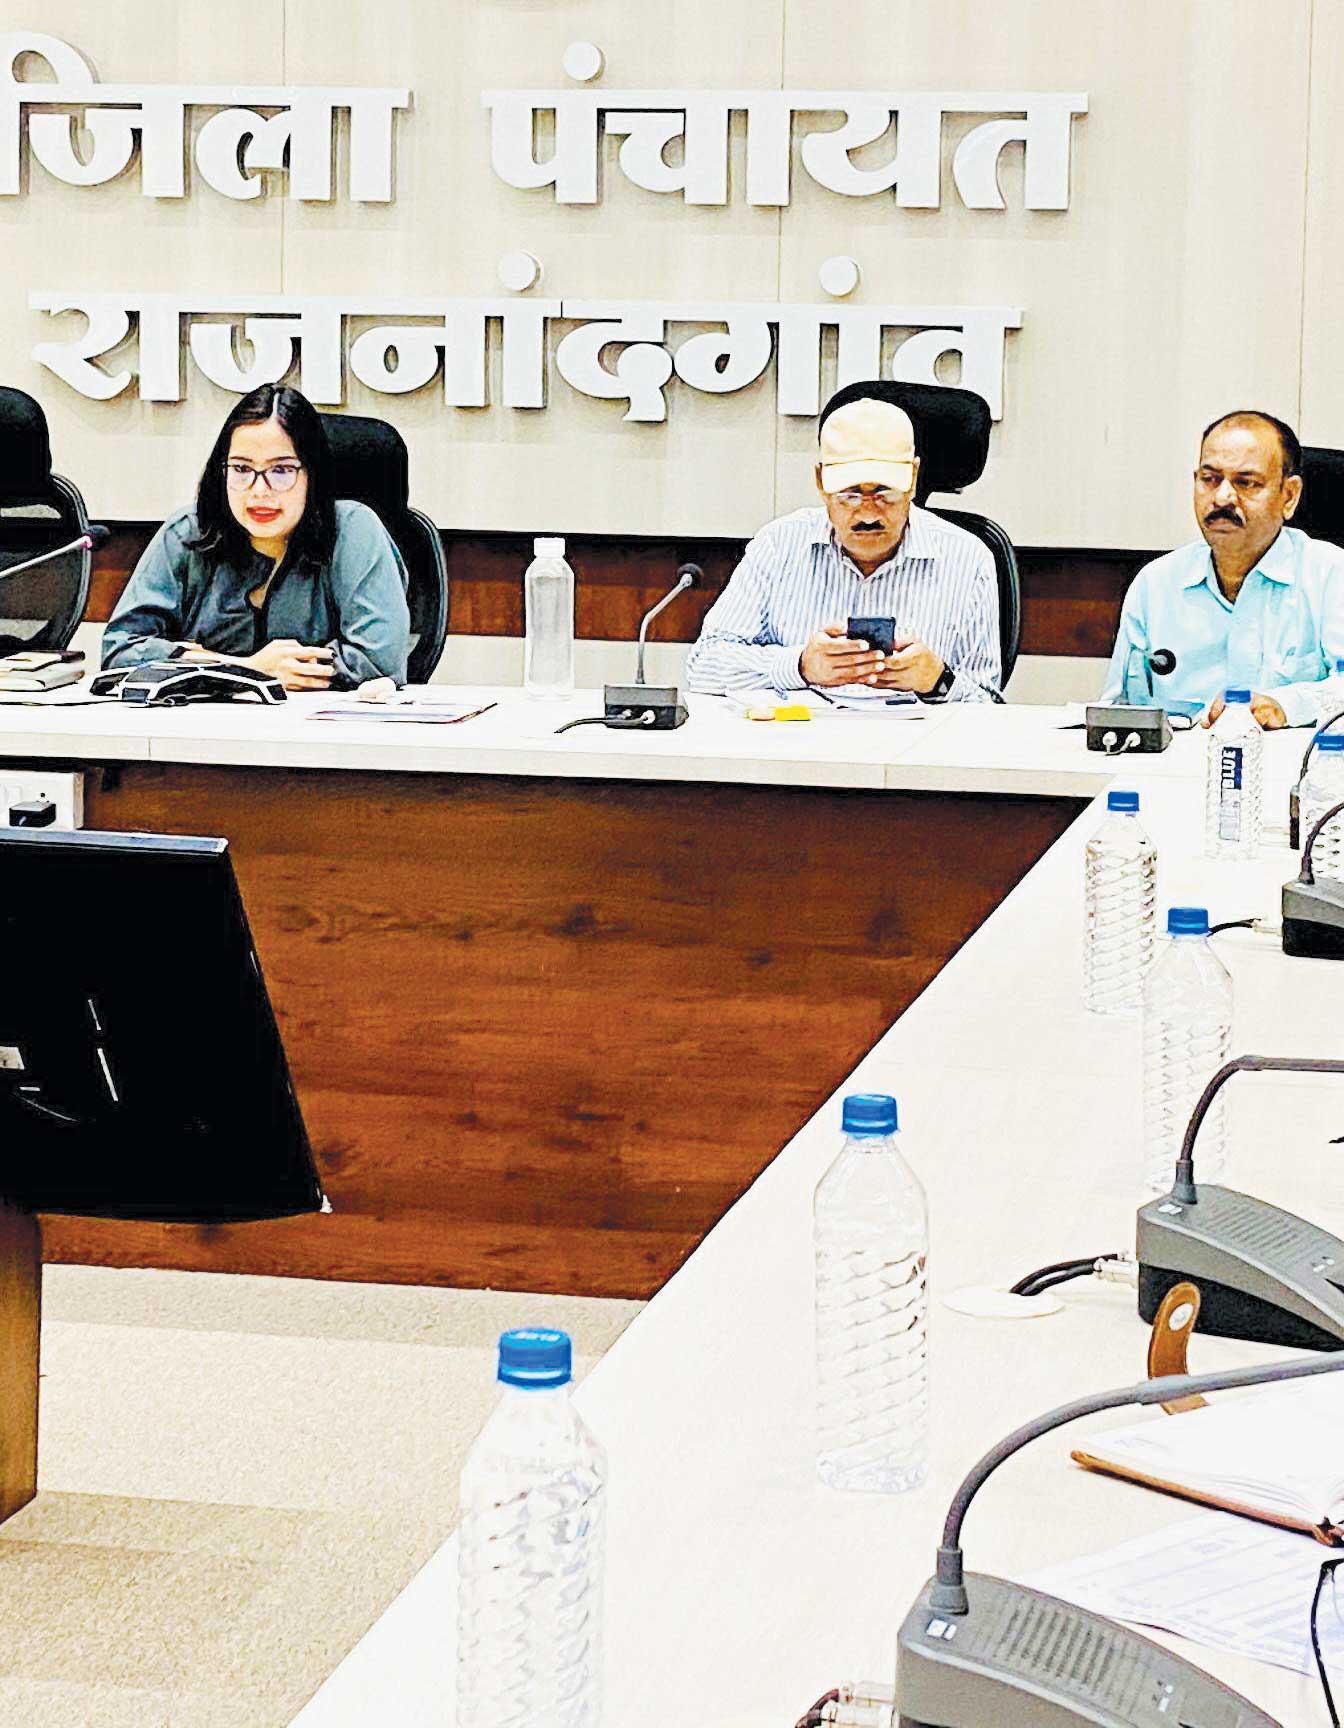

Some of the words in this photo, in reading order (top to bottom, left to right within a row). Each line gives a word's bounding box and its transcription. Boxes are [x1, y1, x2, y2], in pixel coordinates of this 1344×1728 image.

[480, 41, 1089, 211] पंचायत
[29, 250, 1024, 422] राजनांदगांव
[1221, 748, 1237, 789] BLUE
